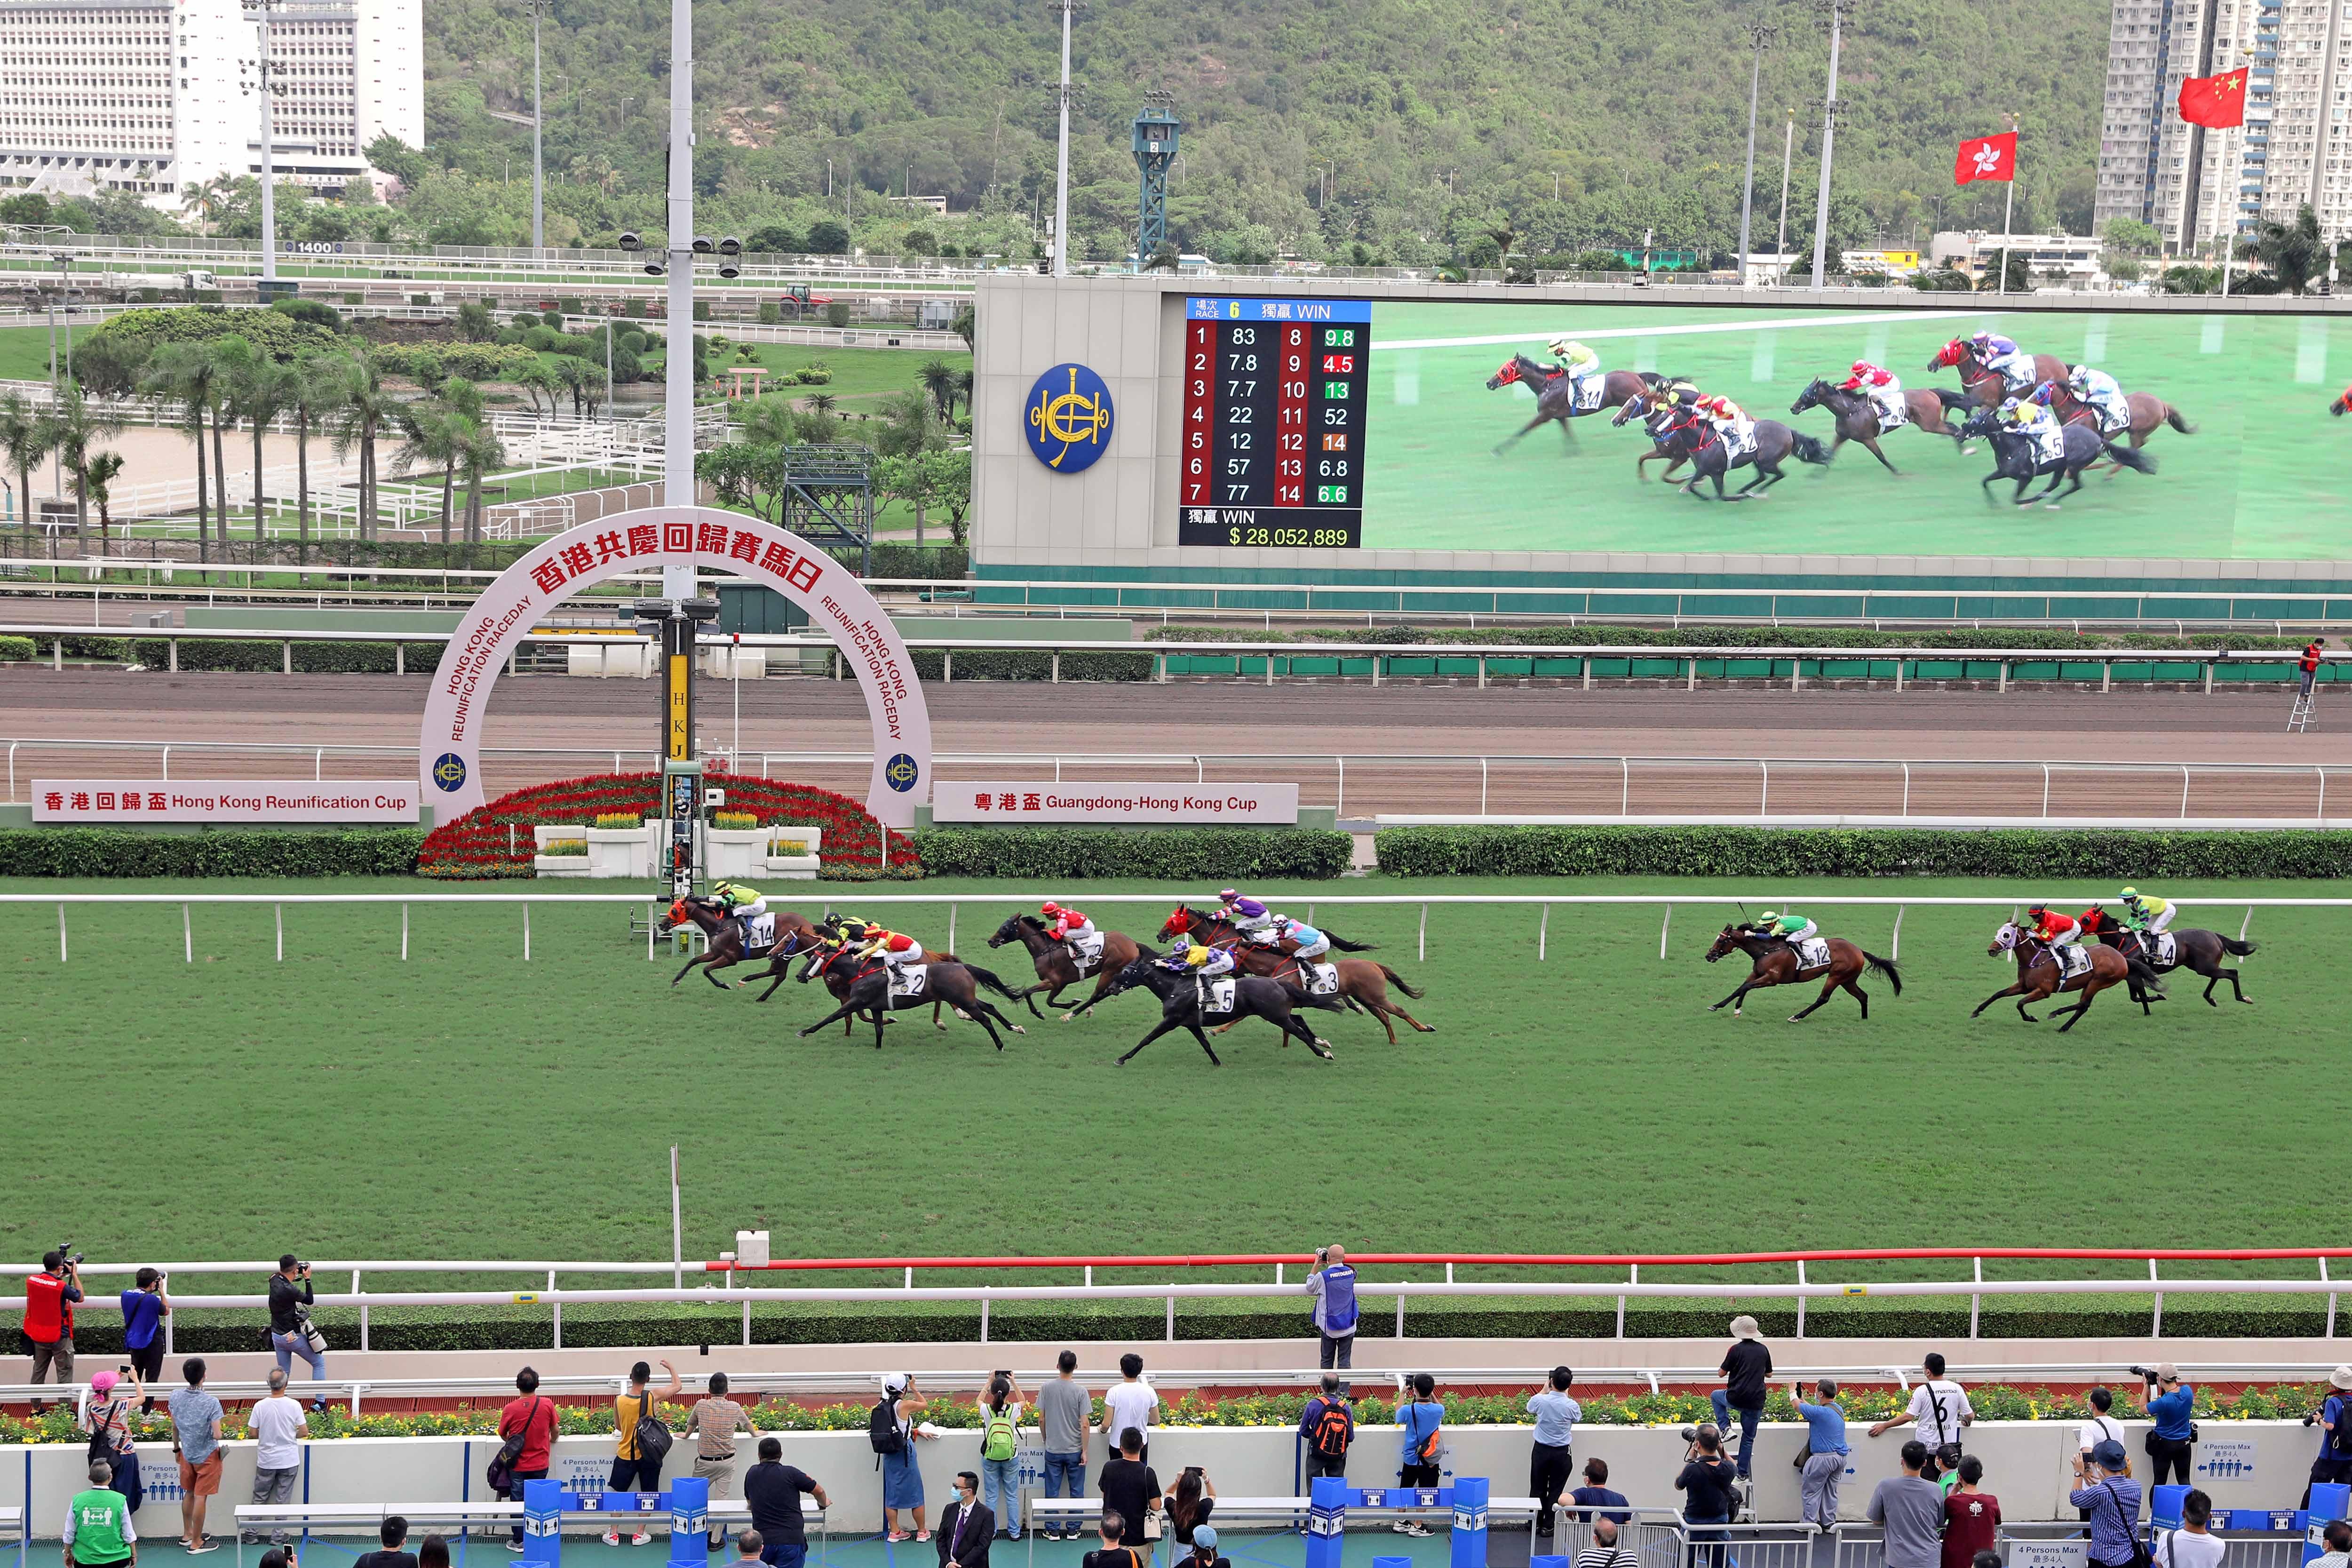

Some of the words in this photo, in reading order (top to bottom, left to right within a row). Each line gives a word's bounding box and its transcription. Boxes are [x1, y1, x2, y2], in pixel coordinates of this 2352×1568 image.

[298, 242, 332, 253] 1400
[1196, 300, 1217, 310] 場次
[1229, 302, 1240, 318] 6
[1262, 304, 1292, 319] 獨贏
[1297, 304, 1331, 319] WIN
[1197, 327, 1205, 344] 1
[1232, 328, 1255, 345] 83
[1290, 329, 1302, 346] 8
[1325, 330, 1354, 347] 9.8
[1195, 354, 1206, 371] 2
[1229, 354, 1257, 371] 7.8
[1289, 355, 1301, 372] 9
[1323, 356, 1353, 373] 4.5
[1194, 380, 1205, 397] 3
[1228, 381, 1256, 397] 7.7
[1284, 382, 1305, 398] 10
[1327, 382, 1349, 399] 13
[1587, 391, 1599, 407] 14
[1192, 406, 1204, 422] 4
[1229, 407, 1253, 423] 22
[1282, 407, 1302, 424] 11
[1324, 408, 1347, 425] 52
[2120, 406, 2129, 426] 3
[1191, 432, 1203, 449] 5
[1230, 433, 1251, 449] 12
[1281, 434, 1303, 451] 12
[1324, 435, 1346, 451] 14
[1747, 433, 1757, 450] 2
[2053, 437, 2062, 456] 5
[1191, 458, 1202, 475] 6
[1227, 459, 1251, 475] 57
[1280, 460, 1302, 476] 13
[1319, 460, 1348, 477] 6.8
[1190, 484, 1201, 501] 7
[1227, 485, 1249, 501] 77
[1279, 485, 1300, 502] 14
[1318, 486, 1347, 502] 6.6
[1188, 509, 1217, 524] 獨贏
[1223, 509, 1255, 524] WIN
[1229, 526, 1240, 545] $
[1246, 528, 1348, 547] 28,052,889
[530, 523, 823, 595] 香港共慶回歸賽馬日
[447, 655, 471, 695] HONG
[465, 617, 495, 655] KONG
[861, 620, 890, 659] HONG
[884, 660, 907, 700] KONG
[452, 647, 492, 741] REUNIFICATION
[486, 595, 532, 648] RACEDAY
[821, 595, 885, 679] REUNIFICATION
[878, 680, 901, 740] RACEDAY
[45, 792, 167, 811] 香港回歸盃
[173, 796, 214, 810] Hong
[220, 796, 262, 811] Kong
[267, 796, 369, 808] Reunification
[375, 796, 407, 810] Cup
[975, 794, 1041, 811] 粵港盃
[1047, 796, 1178, 812] Guangdong-Hong
[1184, 797, 1222, 812] Kong
[1228, 798, 1257, 812] Cup
[760, 925, 773, 943] 14
[1814, 946, 1830, 965] 12
[2164, 945, 2173, 964] 4
[911, 974, 924, 994] 2
[1328, 972, 1337, 992] 3
[1223, 990, 1232, 1011] 5
